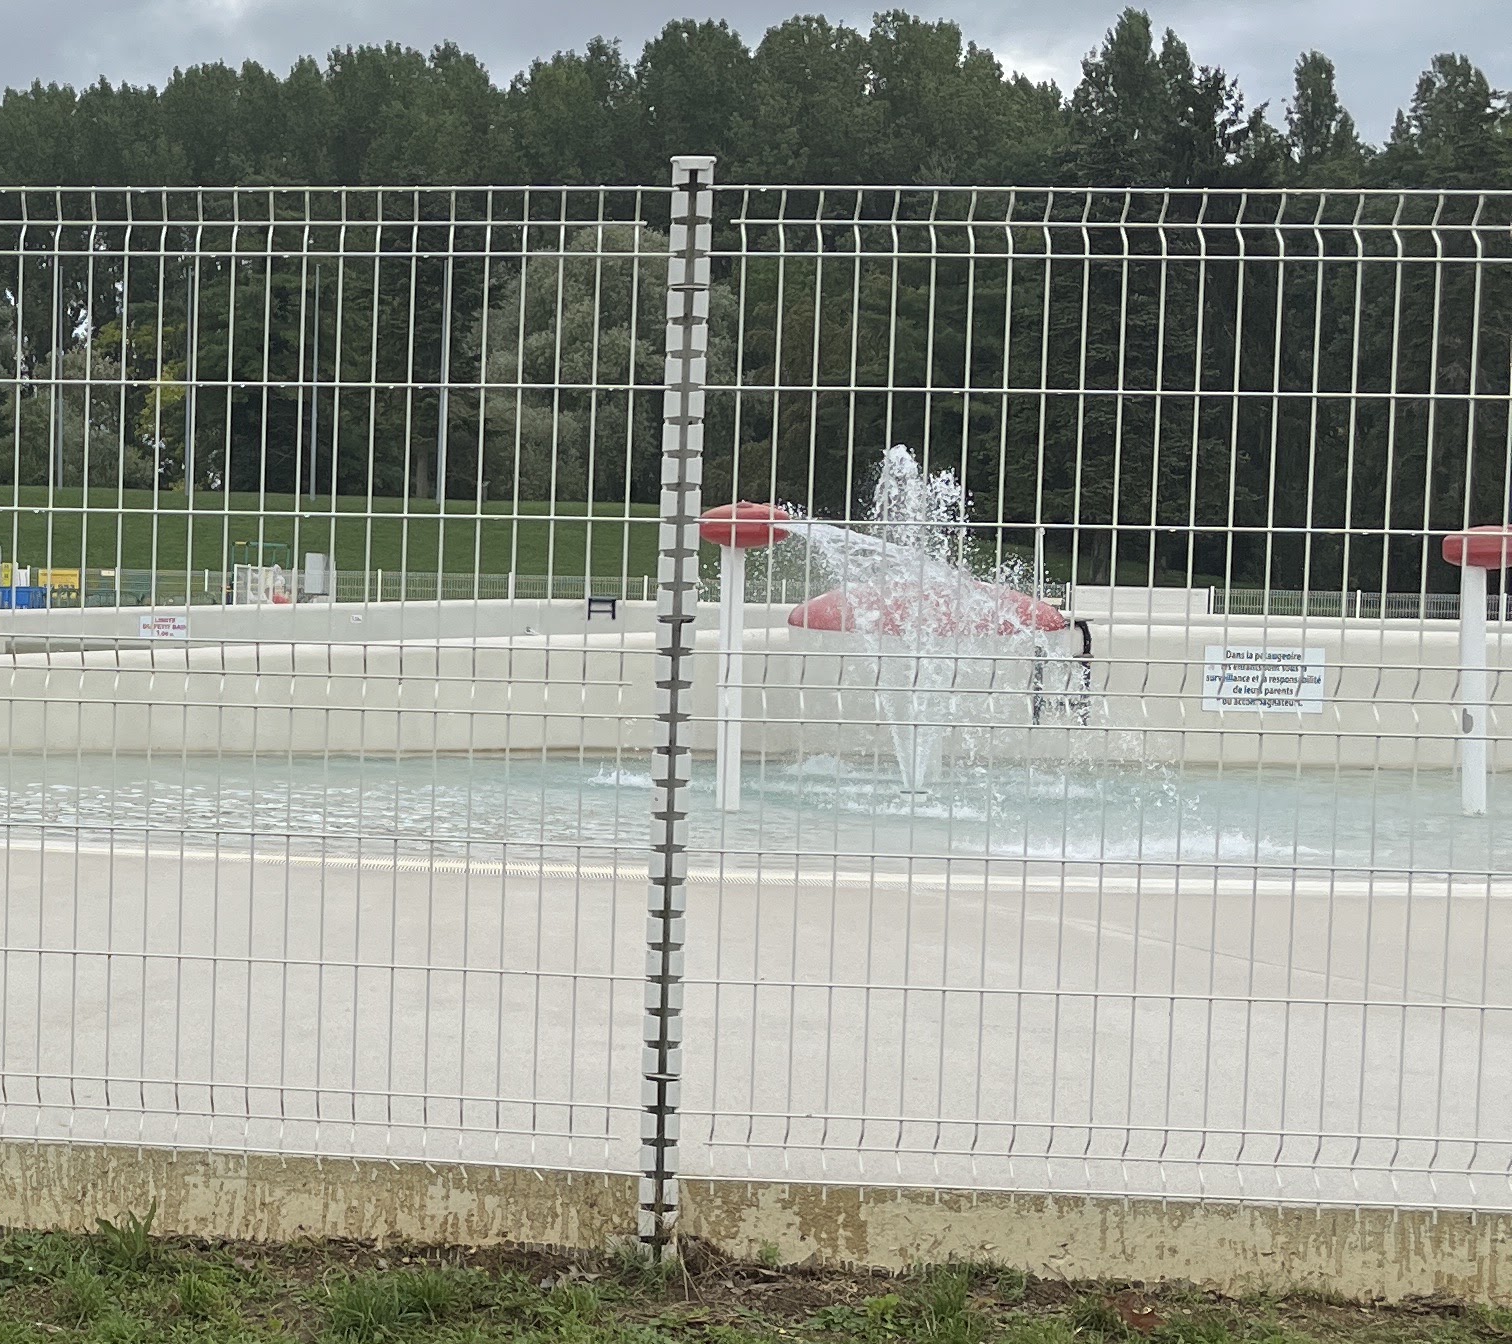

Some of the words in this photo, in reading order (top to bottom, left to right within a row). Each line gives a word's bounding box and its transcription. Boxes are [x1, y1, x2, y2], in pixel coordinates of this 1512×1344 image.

[1226, 650, 1245, 660] Dans
[1246, 650, 1253, 660] la
[1206, 673, 1250, 684] survillance
[1251, 674, 1259, 684] et
[1269, 674, 1322, 686] responsbilité
[1232, 684, 1243, 695] de
[1264, 686, 1294, 696] parents
